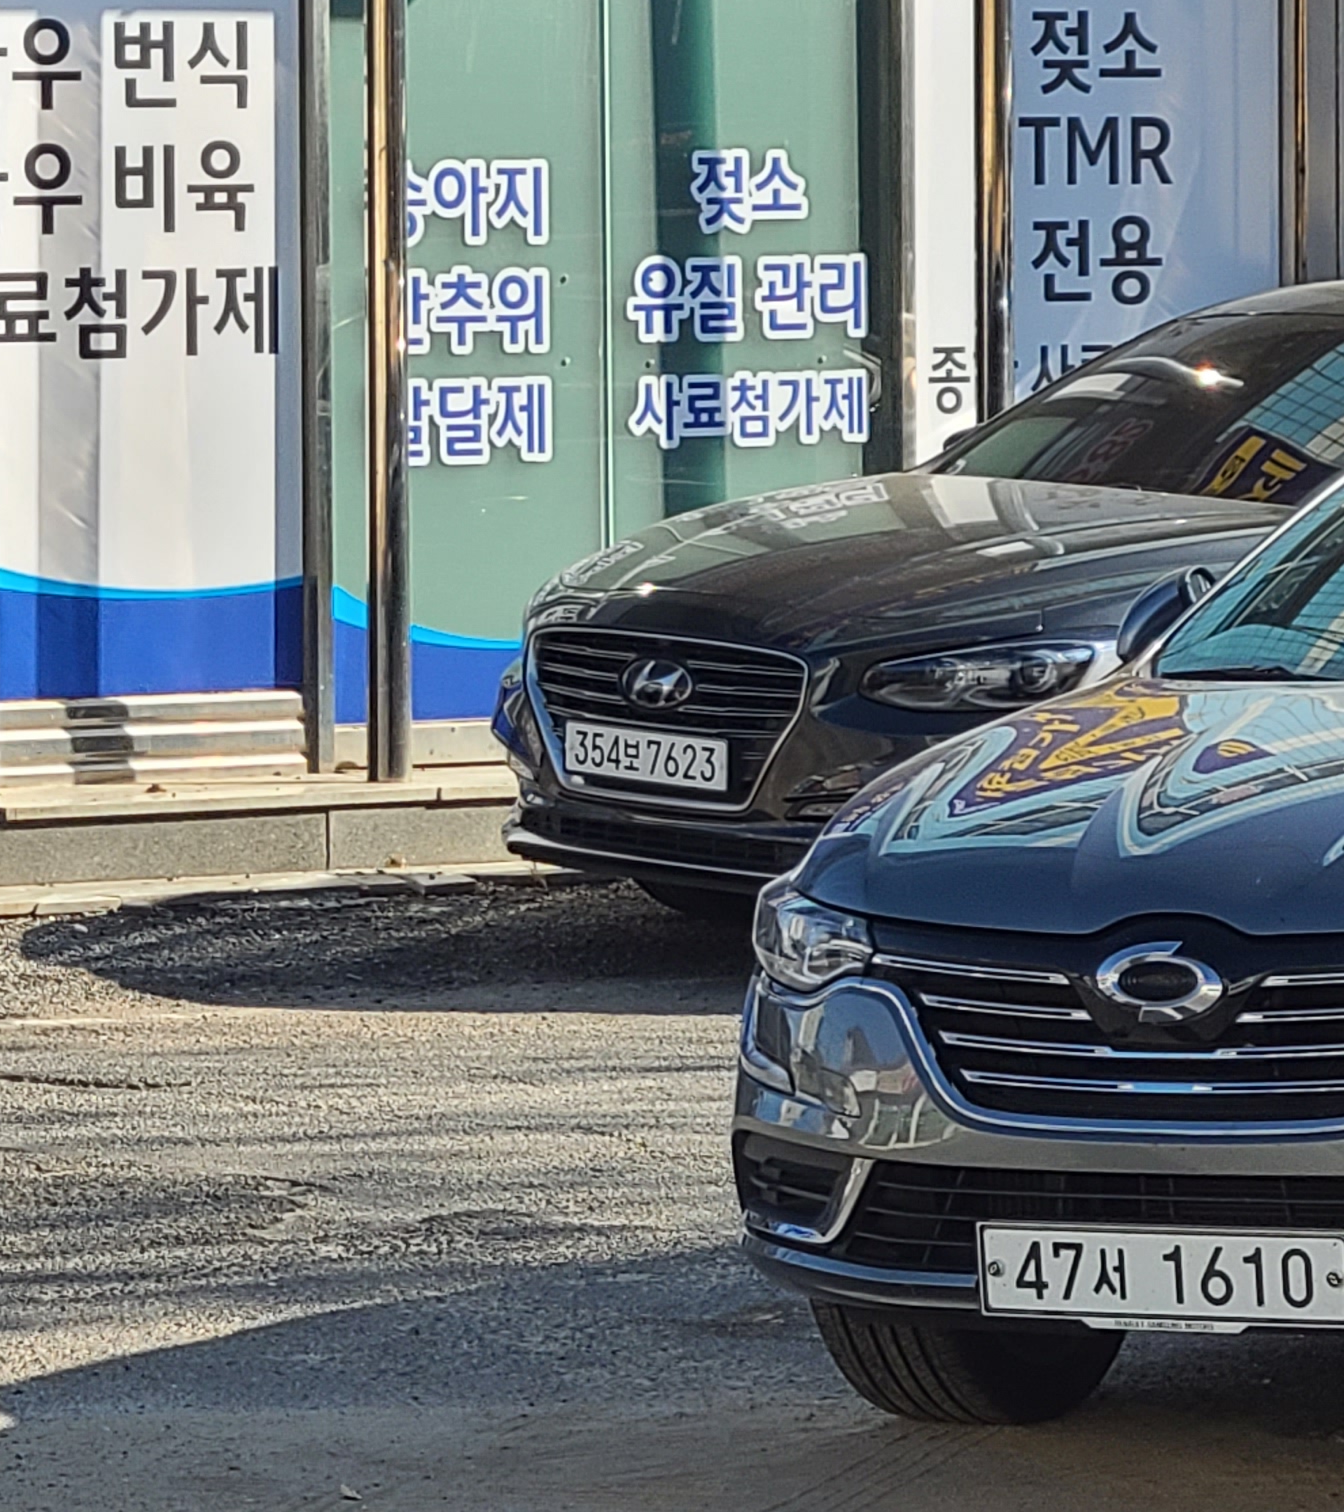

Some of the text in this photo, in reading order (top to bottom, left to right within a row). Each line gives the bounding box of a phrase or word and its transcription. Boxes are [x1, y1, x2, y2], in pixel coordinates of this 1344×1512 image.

[114, 20, 248, 109] 번식
[1031, 10, 1162, 95] 젖소
[114, 140, 254, 233] 비육
[692, 149, 809, 234] 젖소
[1018, 116, 1173, 186] TMR
[628, 255, 744, 342] 유질
[757, 254, 868, 338] 관리
[1031, 214, 1163, 305] 전용
[629, 369, 869, 448] 사료첨가제
[1014, 1241, 1314, 1309] 47서 1610
